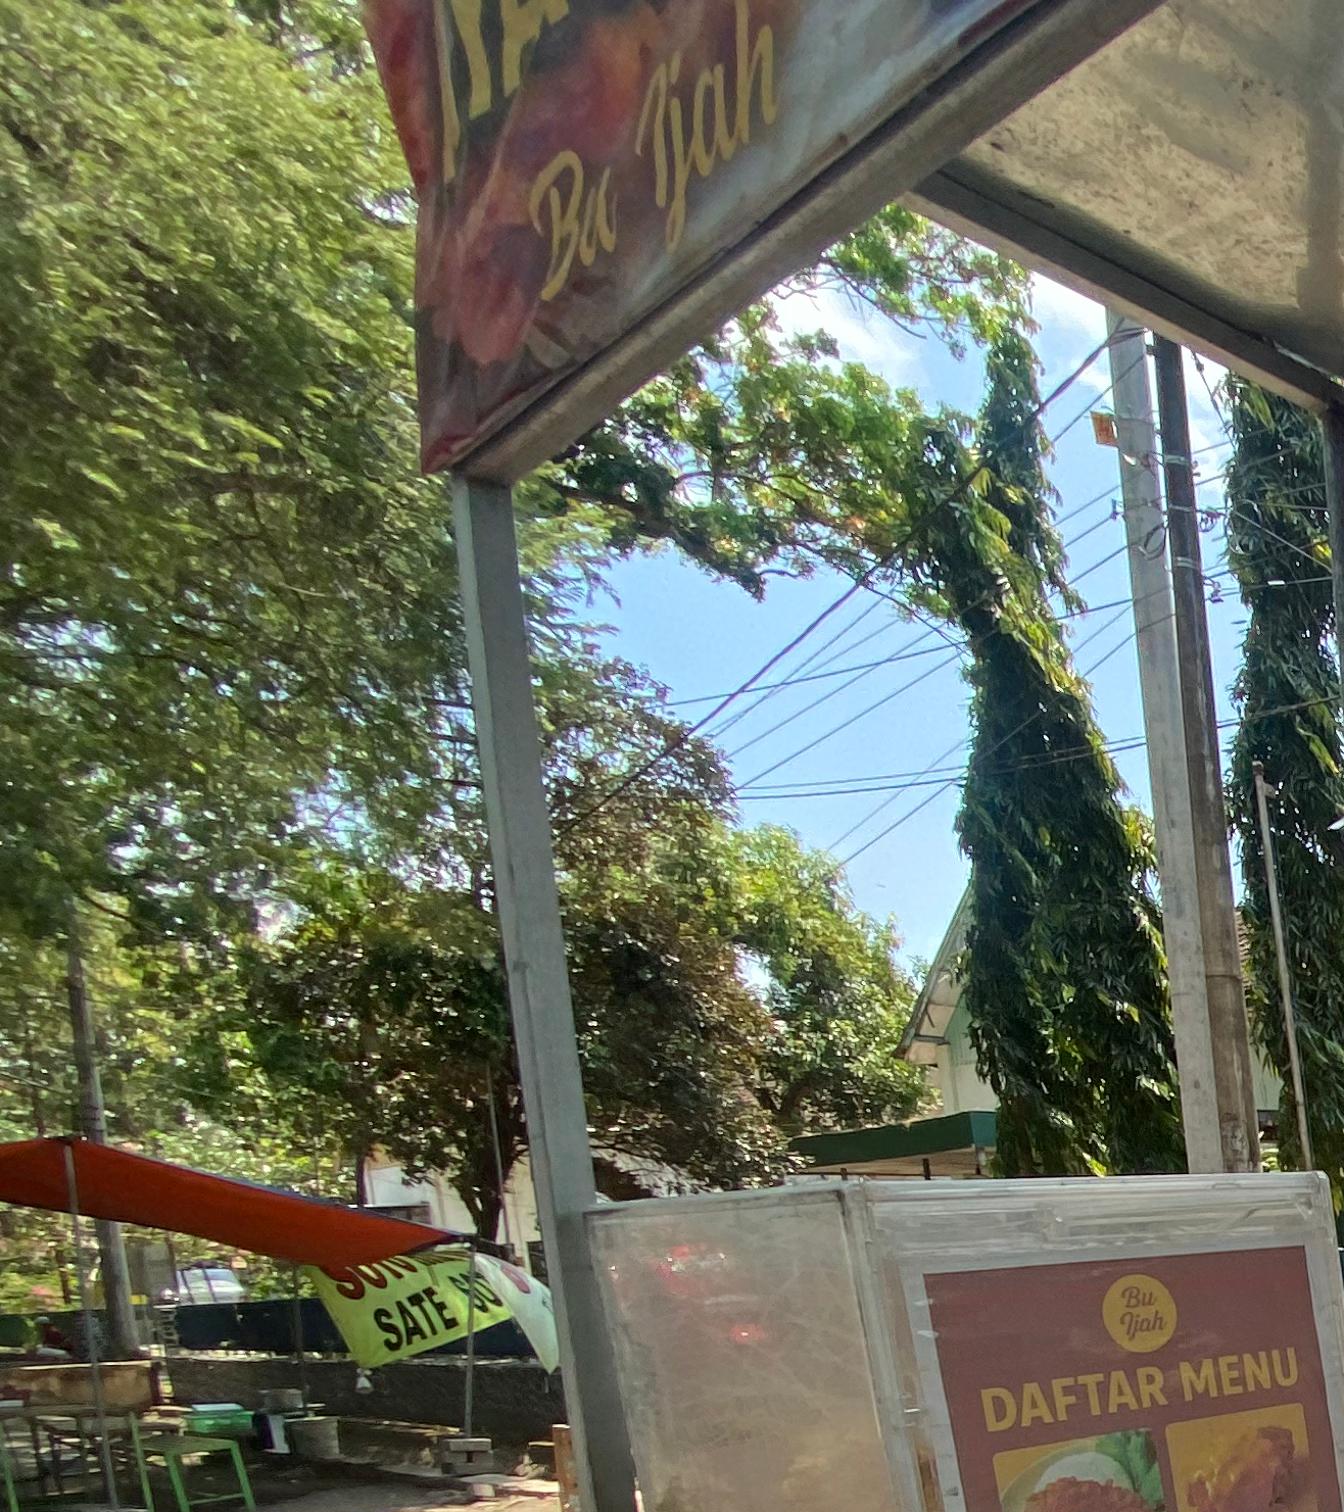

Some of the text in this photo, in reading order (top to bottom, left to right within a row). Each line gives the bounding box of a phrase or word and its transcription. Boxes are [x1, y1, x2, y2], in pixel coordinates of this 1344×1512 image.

[529, 150, 617, 300] Bu
[373, 1286, 458, 1351] SATE
[1120, 1310, 1167, 1341] Ijah
[1121, 1286, 1157, 1308] Bu
[981, 1347, 1299, 1433] DAFTAR MENU
